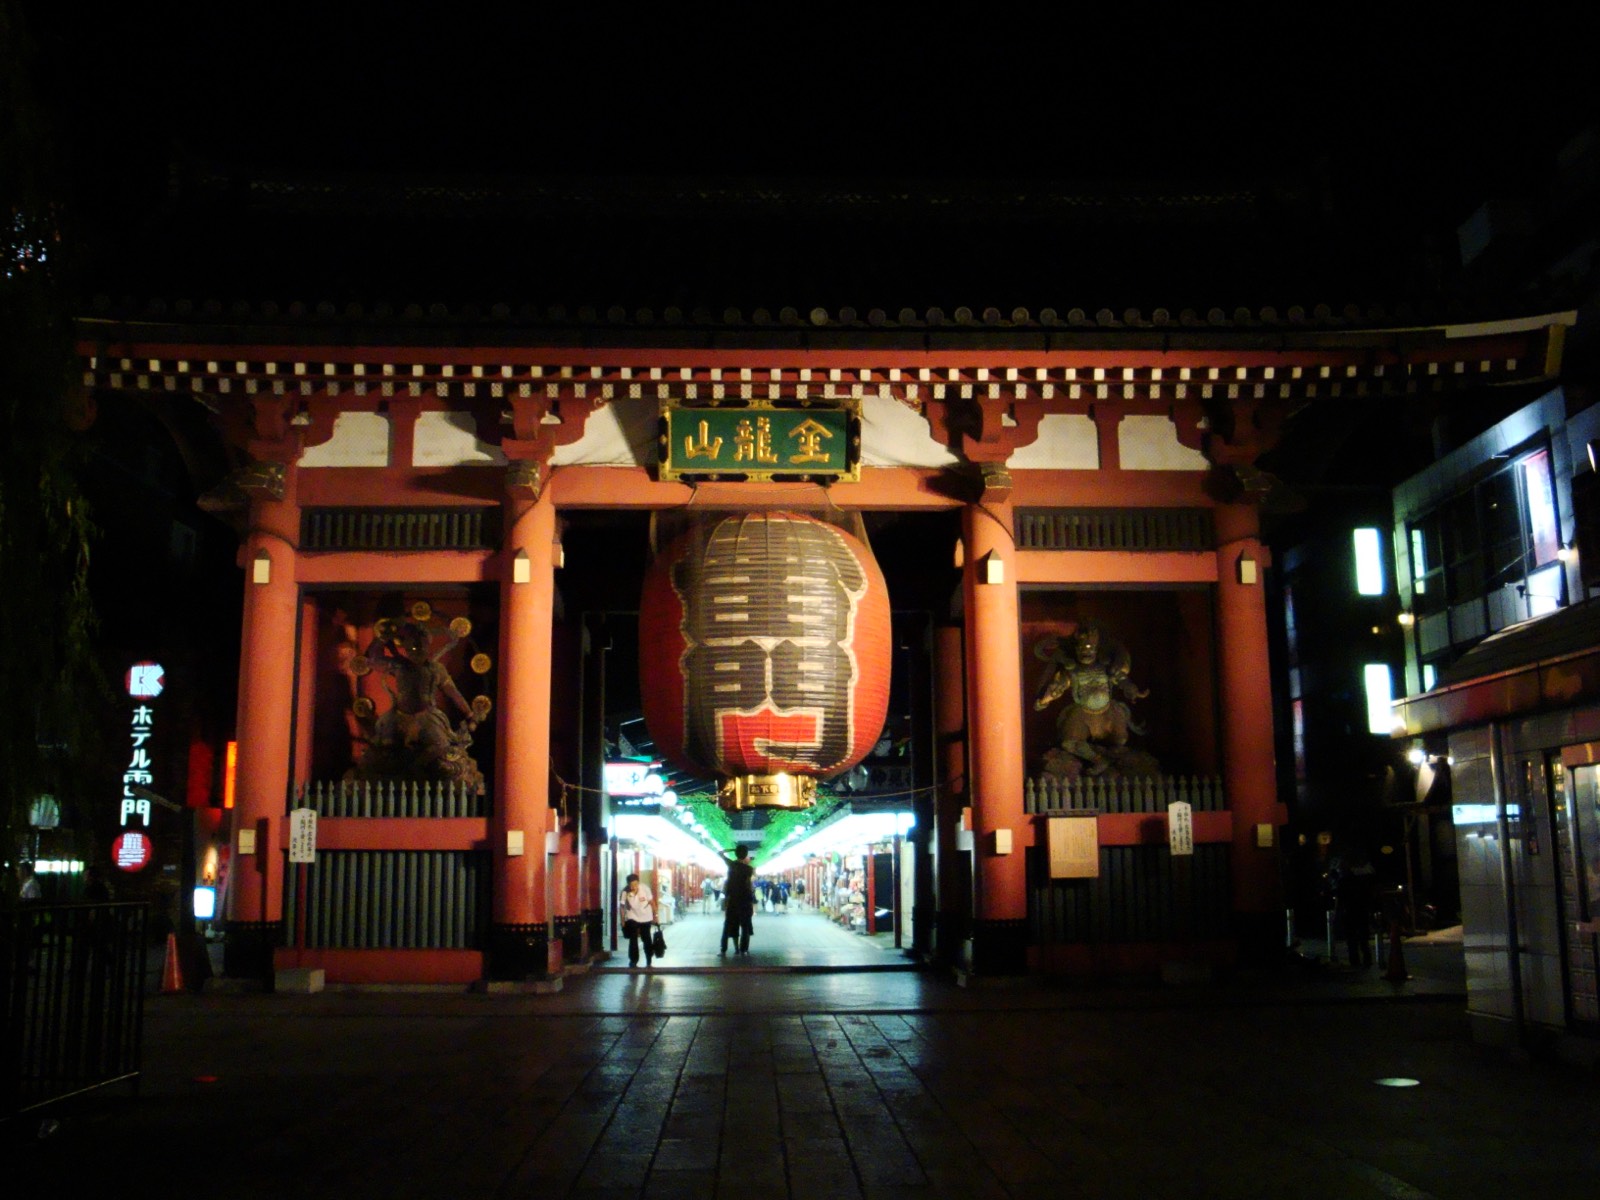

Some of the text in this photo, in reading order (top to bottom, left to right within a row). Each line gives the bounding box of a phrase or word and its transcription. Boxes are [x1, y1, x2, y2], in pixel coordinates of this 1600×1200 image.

[684, 416, 834, 464] 金龍山
[670, 511, 868, 776] 雷門
